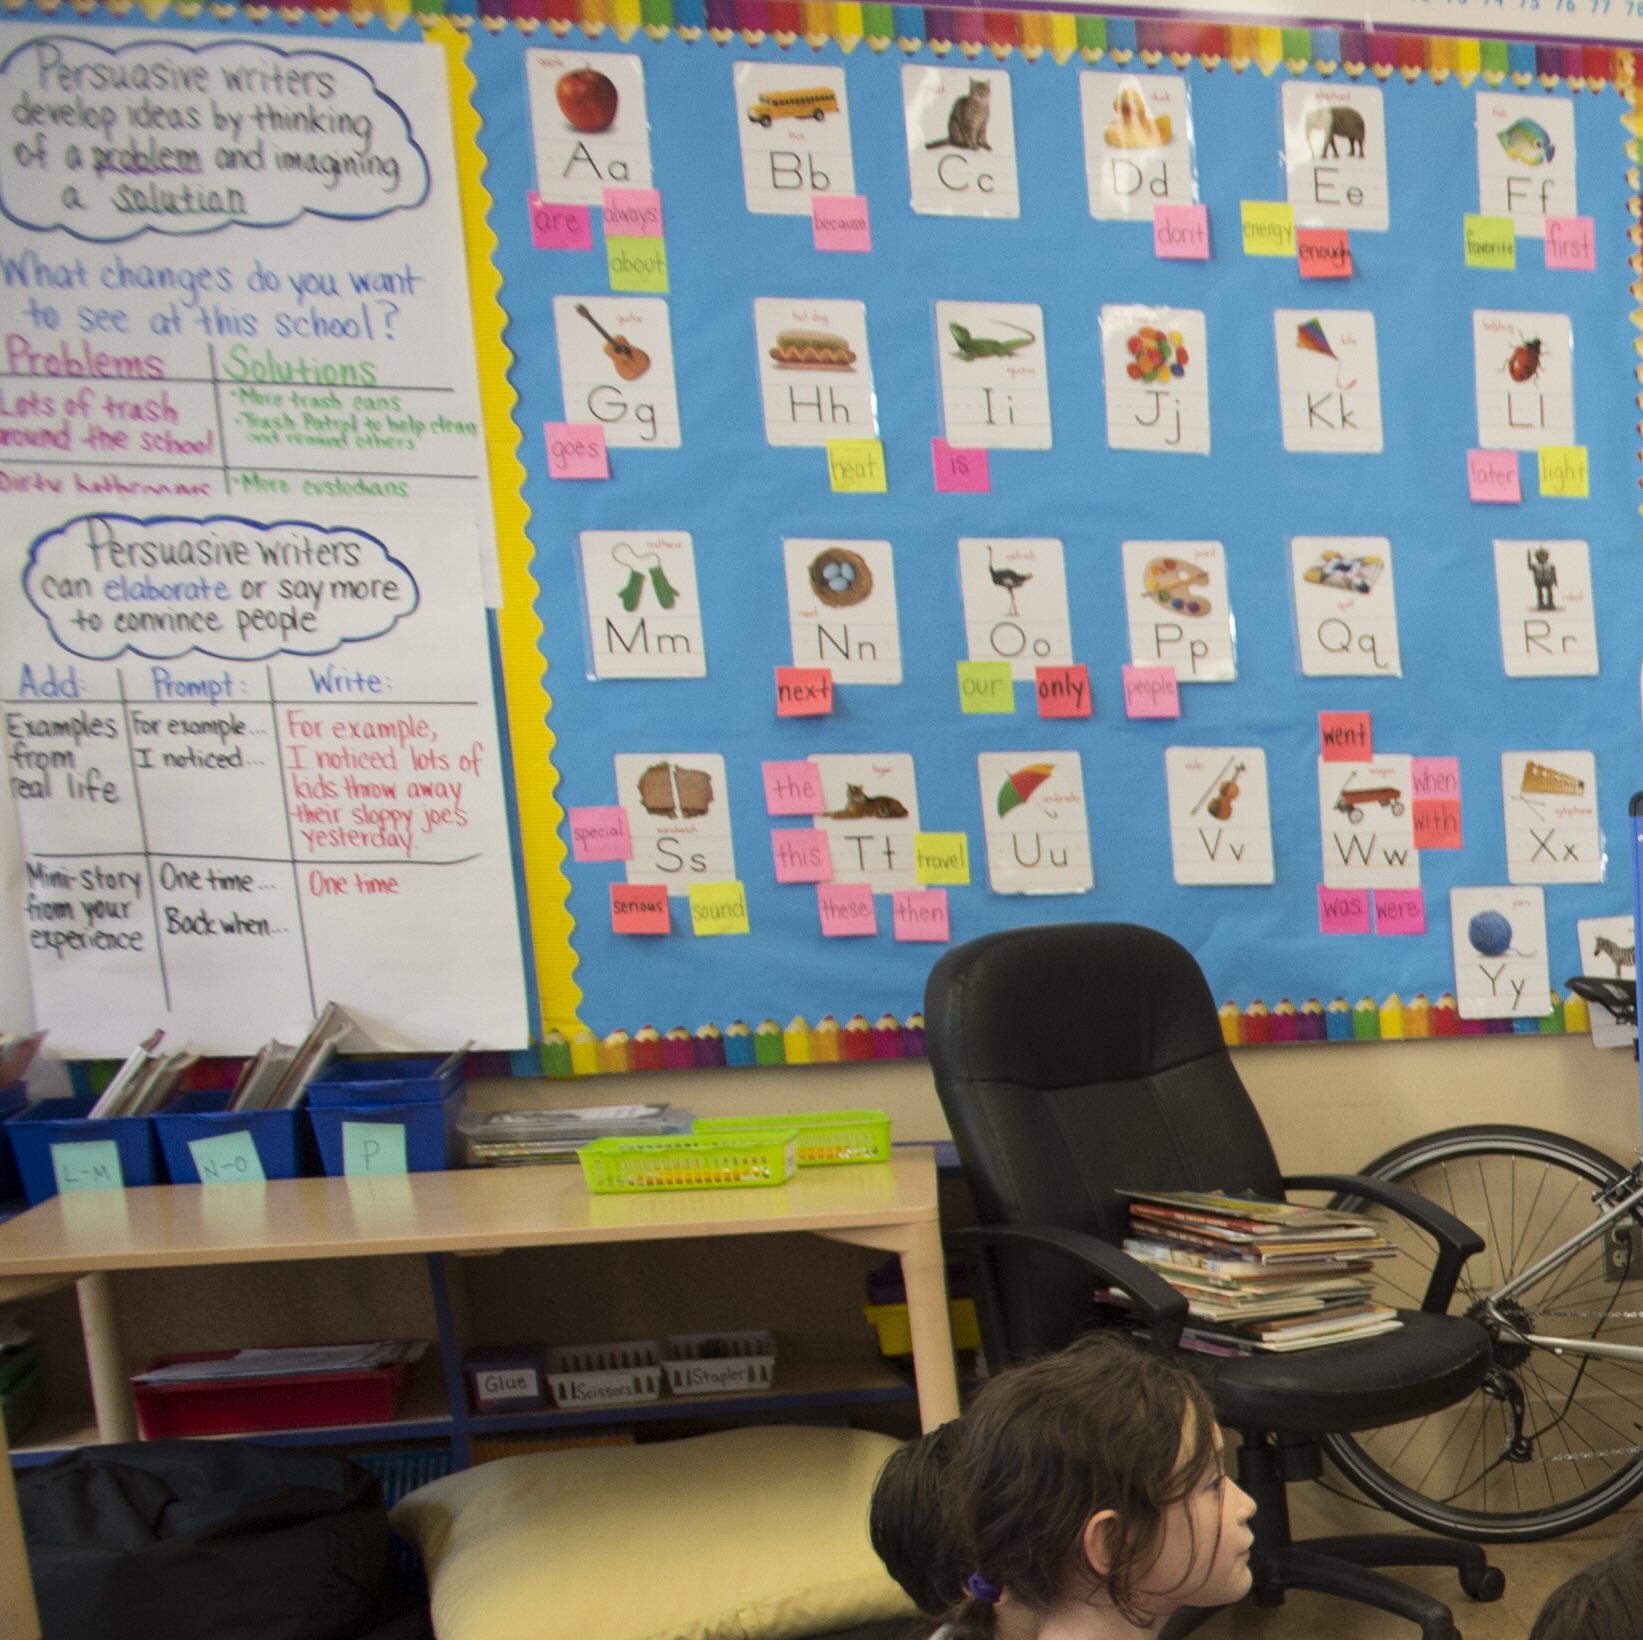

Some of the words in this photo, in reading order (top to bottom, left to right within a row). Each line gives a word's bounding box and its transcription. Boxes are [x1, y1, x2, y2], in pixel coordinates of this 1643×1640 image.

[36, 42, 208, 93] Persuasive
[222, 61, 336, 97] writers
[13, 93, 117, 135] develop
[128, 98, 200, 129] ideas
[212, 109, 244, 140] by
[250, 104, 373, 151] thinking
[535, 208, 581, 232] are
[814, 214, 866, 232] because
[0, 250, 87, 289] What
[101, 255, 232, 302] changes
[247, 260, 281, 293] do
[292, 272, 339, 306] you
[352, 262, 423, 295] want
[25, 300, 59, 329] to
[78, 308, 130, 333] see
[150, 302, 182, 333] at
[196, 302, 257, 337] this
[4, 335, 164, 378] Problems
[224, 345, 377, 386] Solutions
[85, 518, 250, 570] Persuasive
[257, 539, 360, 568] writers
[42, 575, 92, 597] can
[104, 572, 231, 600] elaborate
[240, 577, 264, 597] or
[277, 577, 324, 609] say
[331, 579, 399, 601] more
[71, 609, 101, 631] to
[114, 610, 223, 632] convince
[238, 609, 318, 644] people
[312, 668, 391, 694] Write:
[778, 678, 831, 701] next
[961, 674, 1003, 696] our
[1038, 674, 1084, 708] only
[1323, 725, 1366, 746] went
[773, 780, 814, 797] the
[1413, 803, 1457, 832] with
[778, 846, 822, 868] this
[897, 903, 943, 924] then
[484, 1373, 530, 1395] Glue
[690, 1364, 748, 1386] Stapler
[576, 1380, 632, 1403] Scissors
